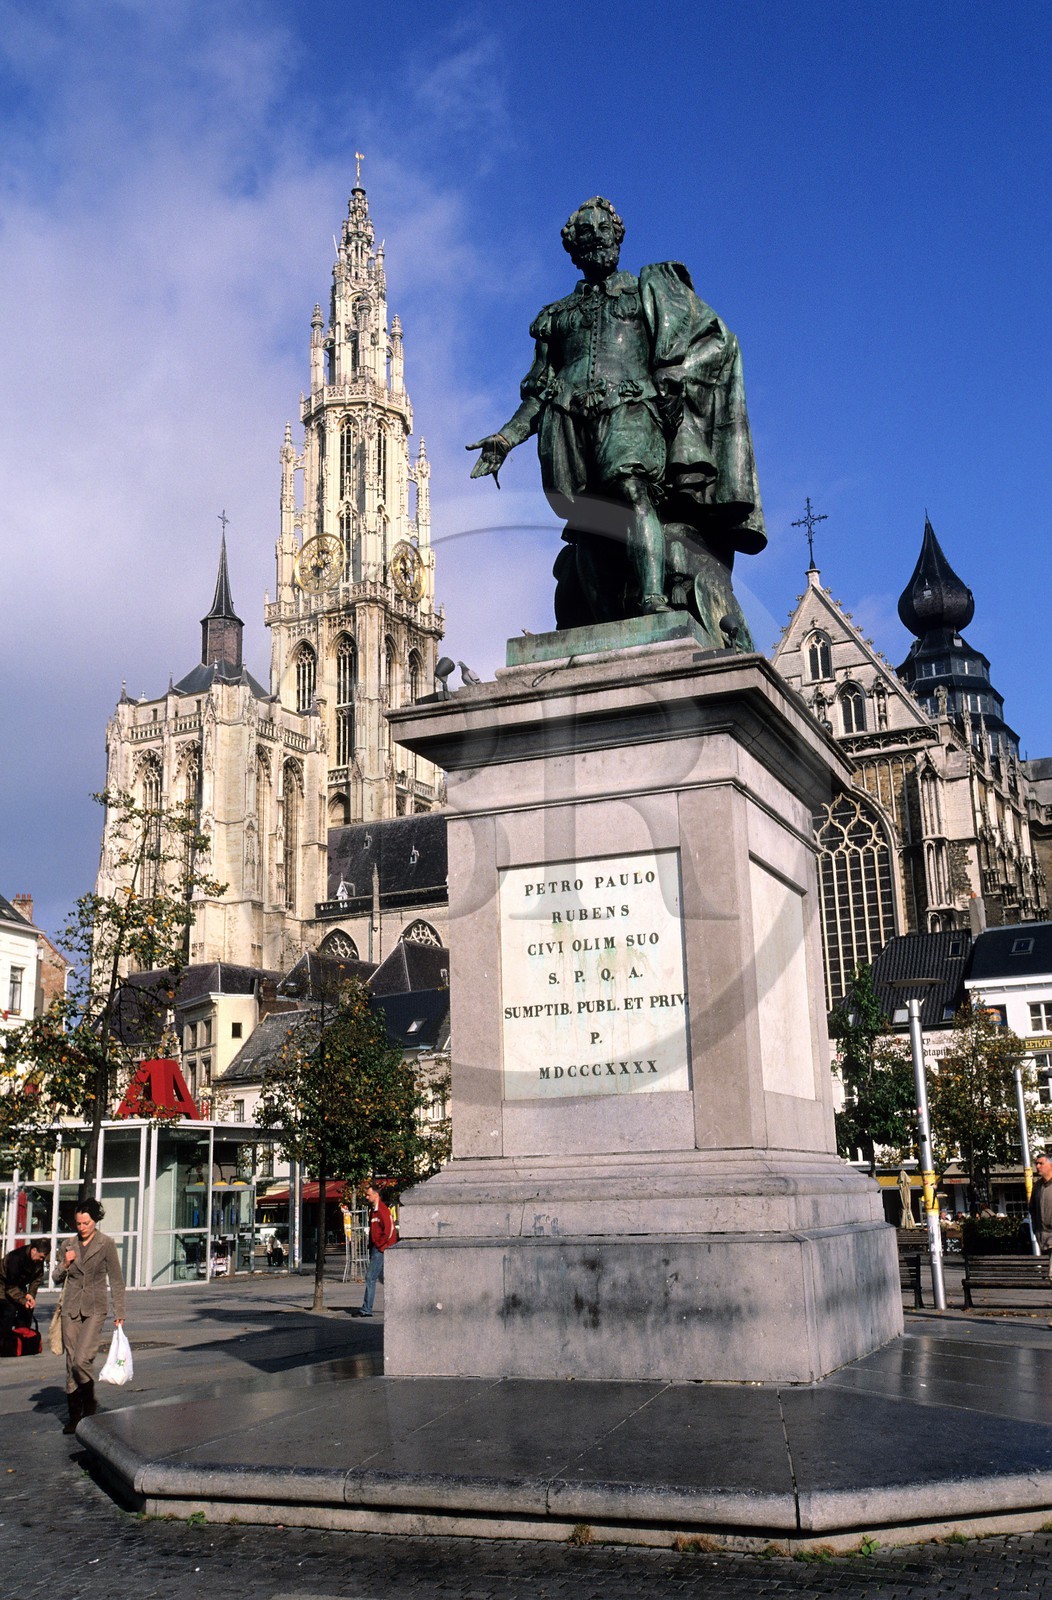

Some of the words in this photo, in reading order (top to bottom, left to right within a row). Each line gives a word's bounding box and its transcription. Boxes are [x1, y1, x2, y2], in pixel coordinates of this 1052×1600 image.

[525, 879, 583, 896] PETRO
[595, 871, 655, 888] PAULO
[552, 905, 629, 923] RUBENS
[528, 941, 563, 955] CIVI
[572, 937, 615, 952] OLIM
[626, 933, 659, 946] SUO
[549, 973, 559, 984] S.
[575, 971, 585, 982] P.
[601, 969, 614, 981] Q.
[629, 967, 642, 978] A.
[505, 1003, 572, 1019] SUMPTIB.
[577, 1000, 619, 1013] PUBL.
[624, 997, 643, 1010] ET
[650, 993, 689, 1008] PRIV.
[591, 1032, 602, 1044] P.
[539, 1060, 658, 1079] MDCCCXXXX
